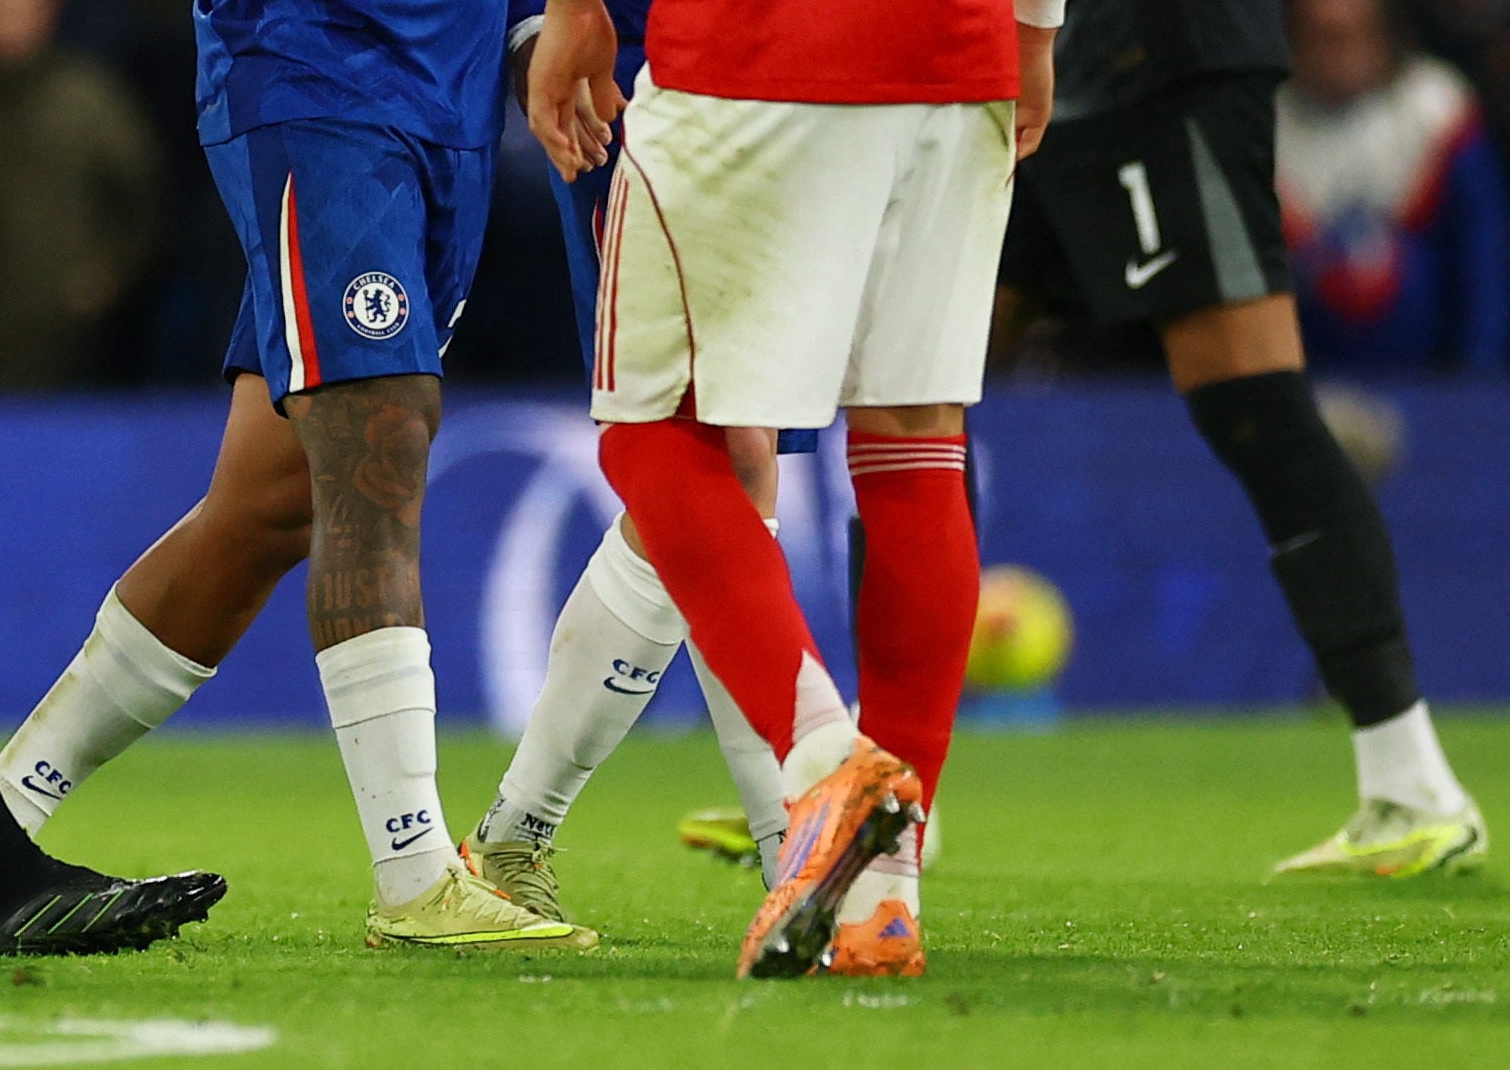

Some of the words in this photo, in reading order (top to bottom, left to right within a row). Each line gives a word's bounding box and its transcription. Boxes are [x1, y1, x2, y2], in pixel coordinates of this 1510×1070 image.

[1117, 161, 1162, 254] 1
[353, 274, 395, 291] CHELSEA
[34, 760, 72, 795] CFC
[385, 809, 432, 833] CFC
